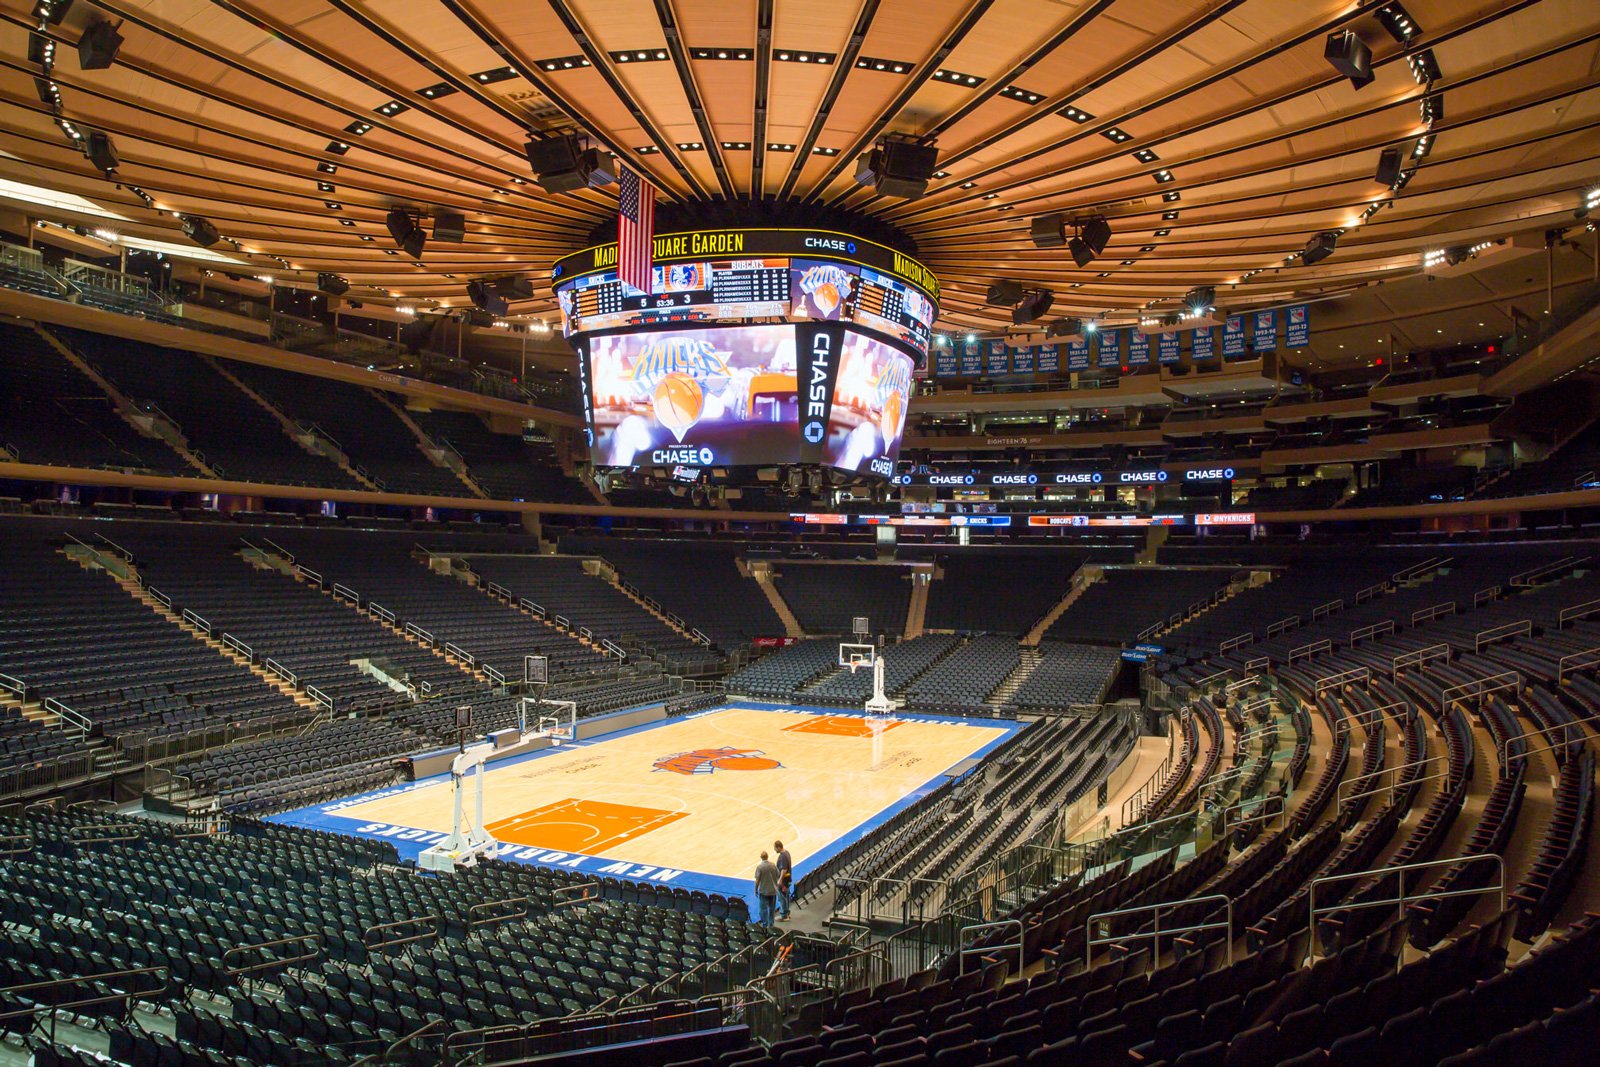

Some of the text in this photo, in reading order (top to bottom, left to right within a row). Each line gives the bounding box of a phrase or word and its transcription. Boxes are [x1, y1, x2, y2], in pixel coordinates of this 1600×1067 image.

[595, 234, 744, 268] MADI QUARE GARDEN
[805, 238, 846, 251] CHASE
[731, 260, 764, 269] BOBCATS
[894, 253, 922, 284] MADISON
[641, 299, 647, 307] 5
[684, 295, 690, 303] 3
[630, 339, 733, 381] KNICKS
[808, 333, 830, 418] CHASE
[653, 450, 698, 463] CHASE
[871, 459, 888, 474] CHASE
[930, 476, 963, 484] CHASE
[993, 475, 1027, 483] CHASE
[1056, 474, 1091, 482] CHASE
[1121, 472, 1156, 481] CHASE
[1186, 470, 1223, 479] CHASE
[357, 823, 684, 881] NEW YORK ICKS
